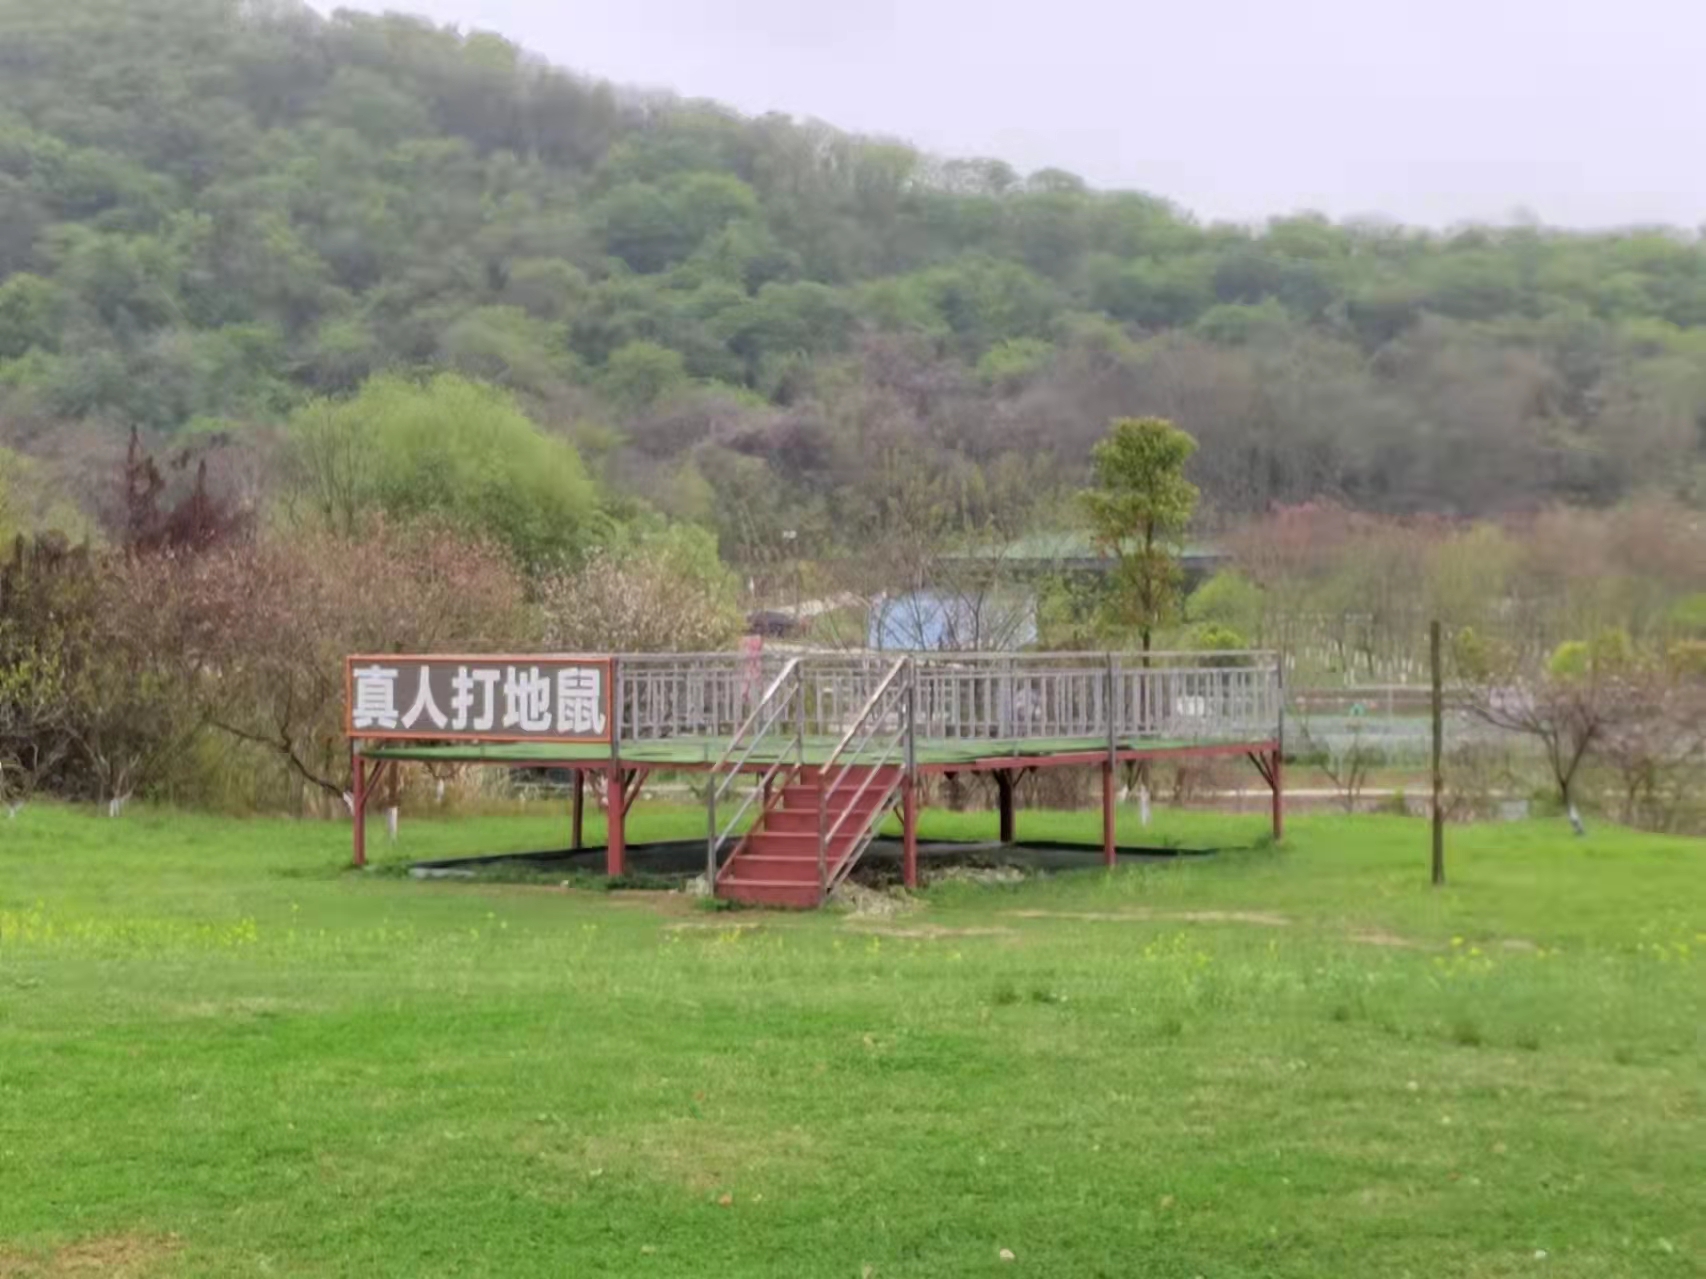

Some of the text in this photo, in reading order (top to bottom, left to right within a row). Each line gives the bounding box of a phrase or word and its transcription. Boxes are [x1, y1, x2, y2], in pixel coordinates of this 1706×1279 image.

[352, 664, 606, 734] 真人打地鼠
